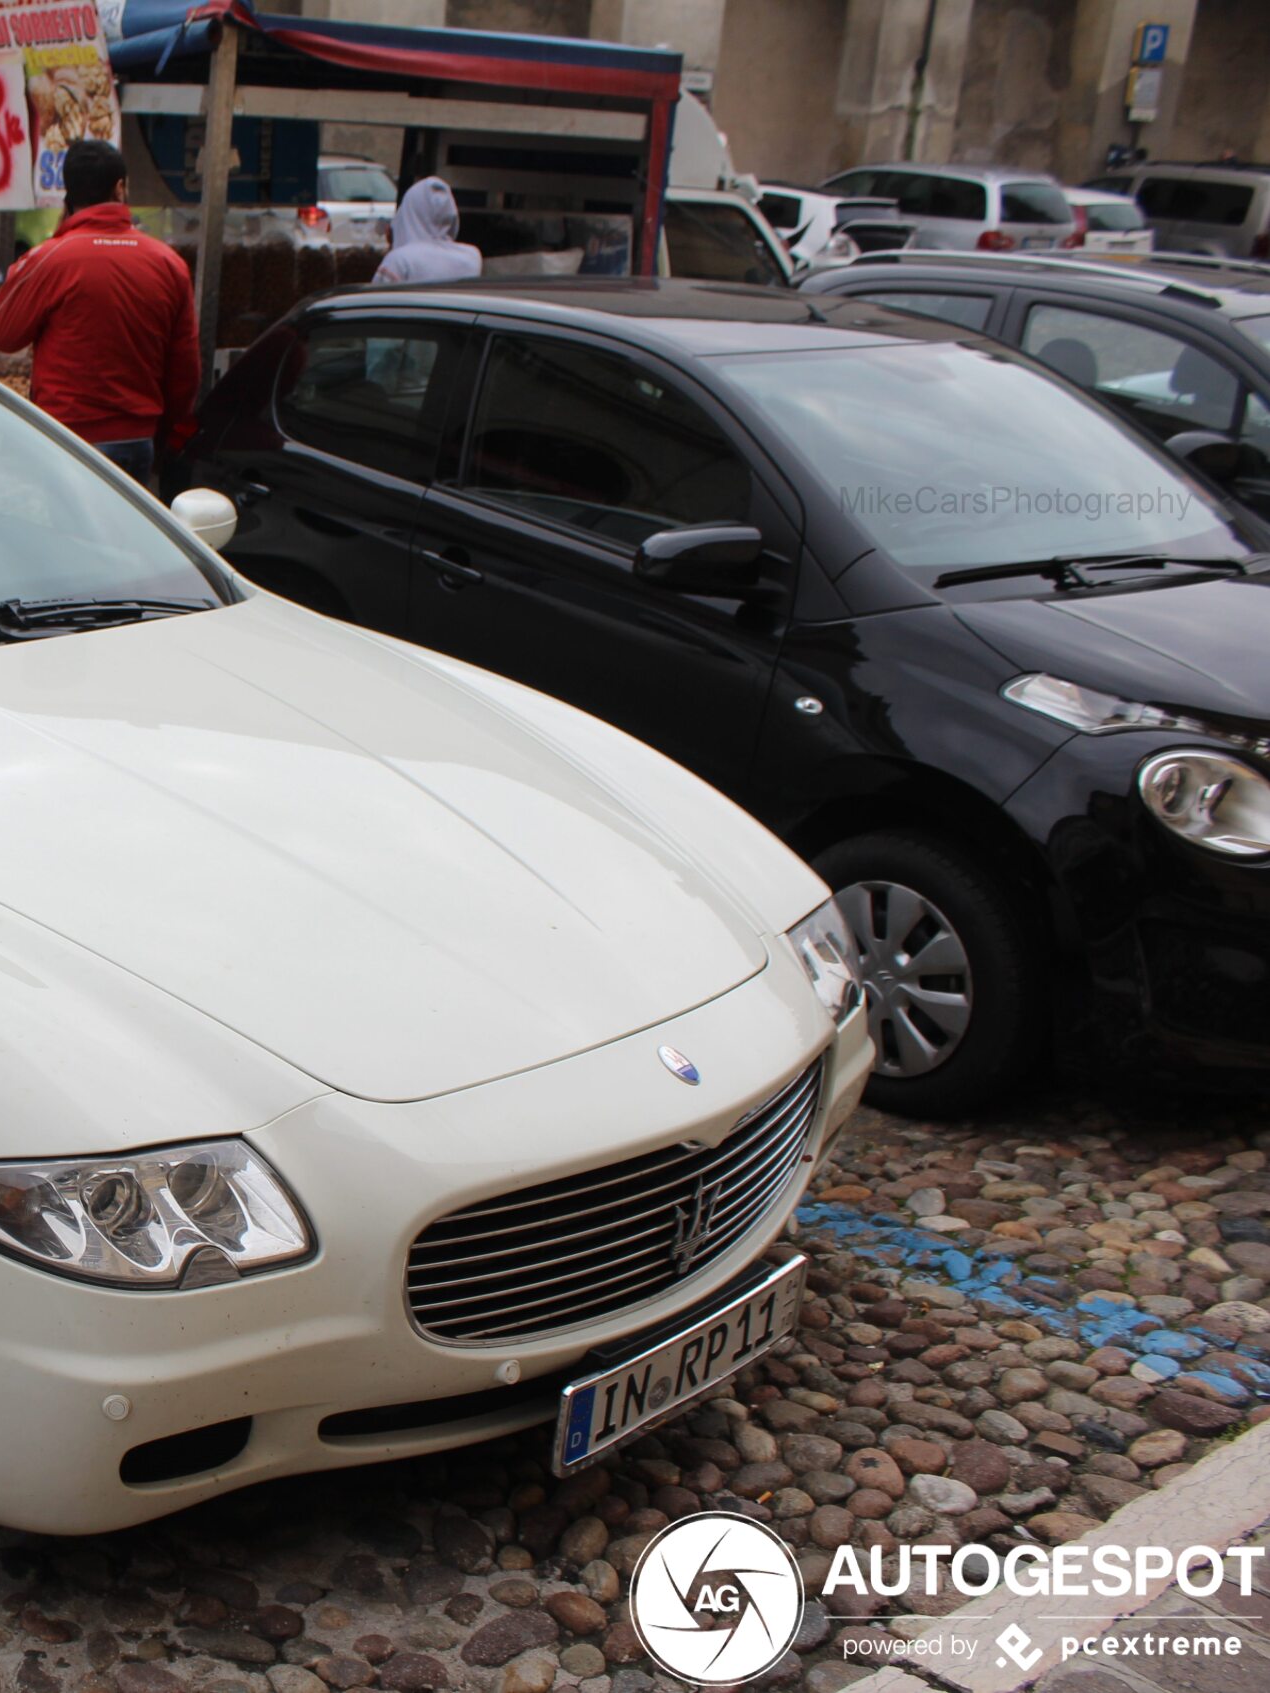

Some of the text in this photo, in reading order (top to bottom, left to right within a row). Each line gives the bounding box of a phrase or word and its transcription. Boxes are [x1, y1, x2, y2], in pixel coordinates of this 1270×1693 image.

[9, 4, 98, 47] SORRENTO
[1143, 28, 1163, 59] P
[595, 1363, 652, 1442] IN
[571, 1432, 581, 1448] D
